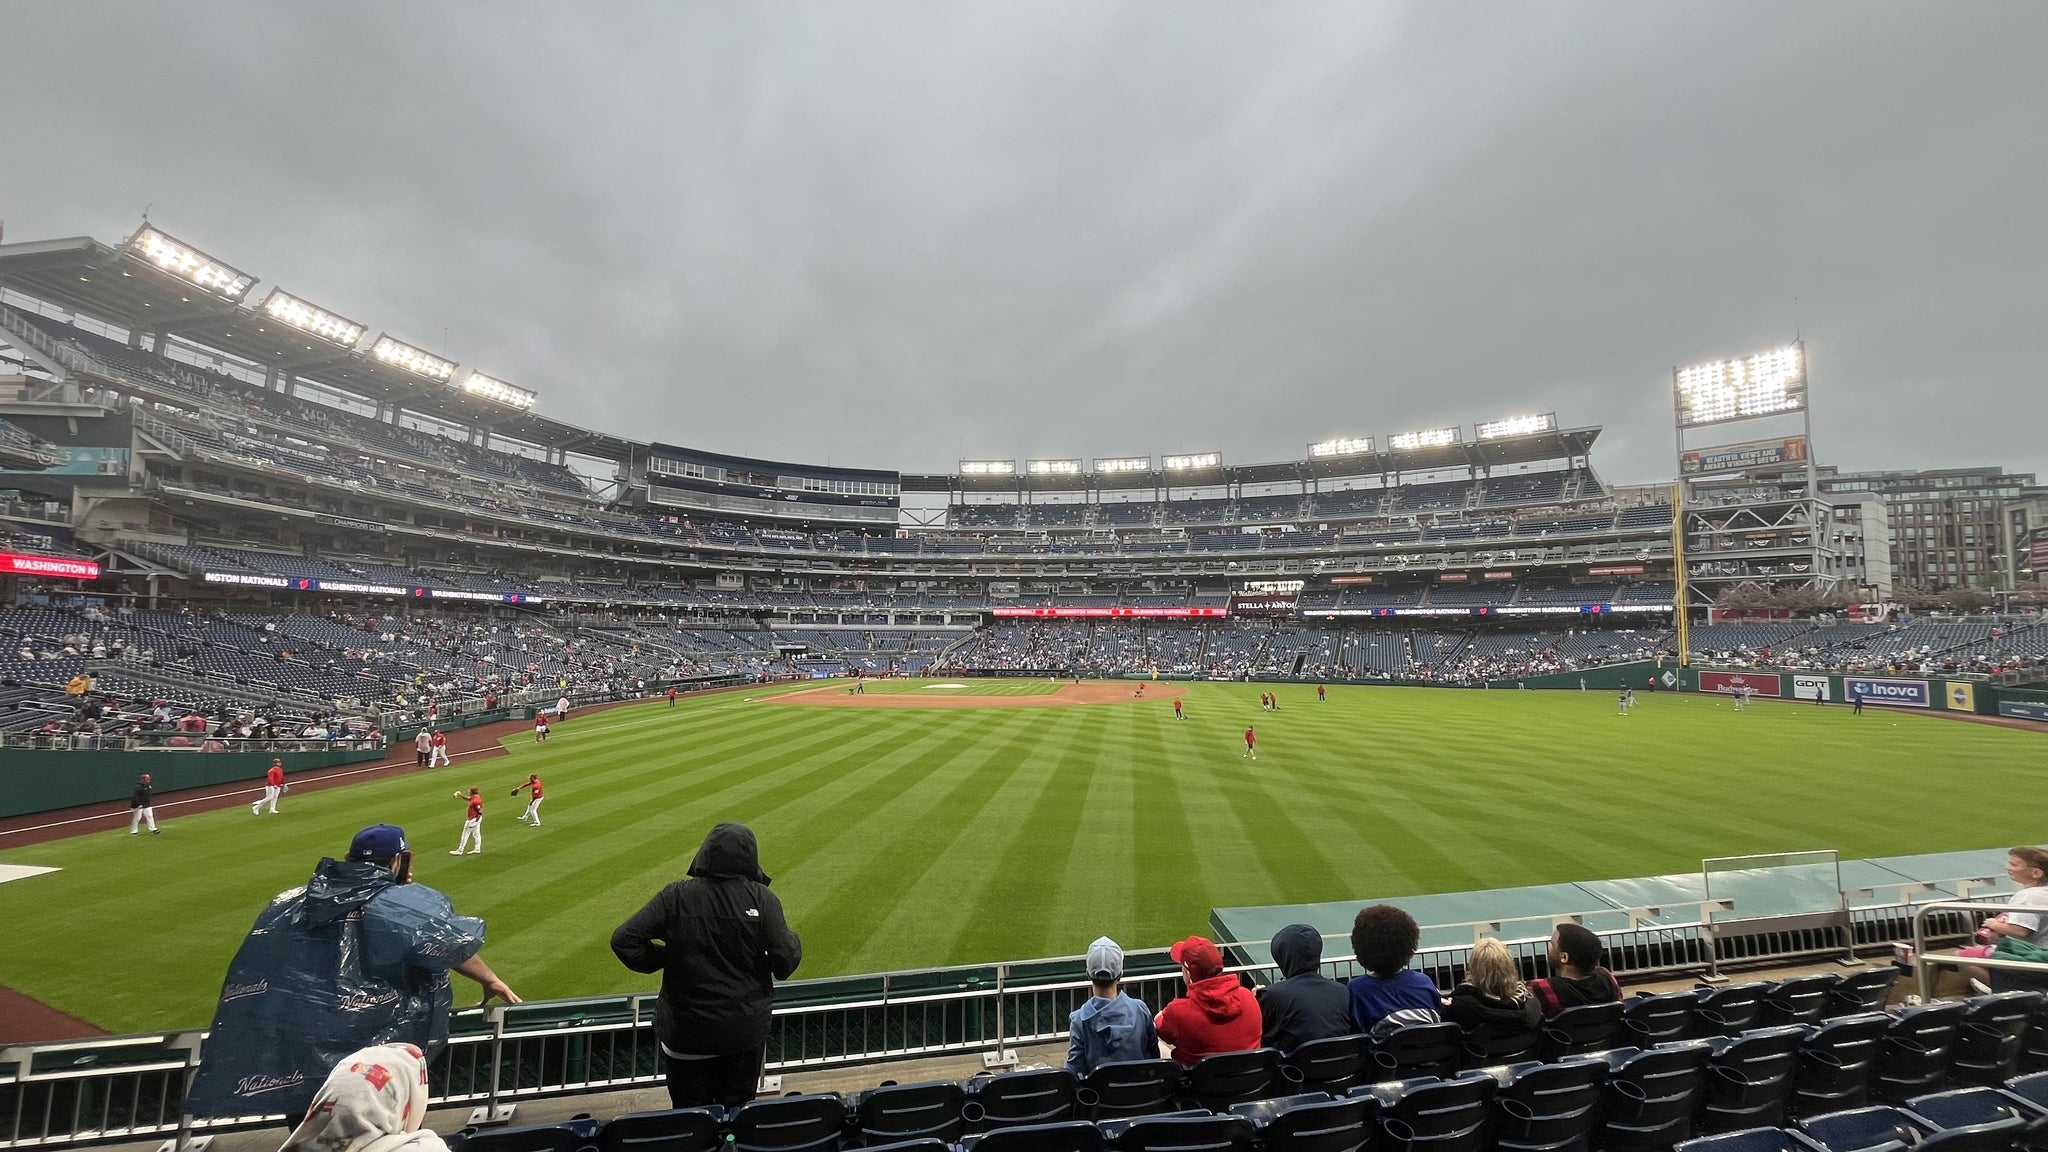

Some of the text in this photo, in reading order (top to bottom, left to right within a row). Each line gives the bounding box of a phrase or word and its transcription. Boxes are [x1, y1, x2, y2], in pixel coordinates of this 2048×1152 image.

[1704, 454, 1781, 471] AWARD WINNING BREWS
[1706, 453, 1738, 464] BEAUTIFUL
[1740, 450, 1761, 460] VIEWS
[1762, 447, 1776, 457] AND
[334, 518, 369, 530] CHAMPIONS
[13, 558, 86, 575] WASHINGTON
[240, 575, 289, 587] NATIONALS
[319, 581, 407, 595] WASHINGTON NATIONALS
[431, 589, 503, 601] WASHINGTON NATIONALS
[1795, 680, 1827, 688] GDIT
[1872, 683, 1918, 697] Inova
[233, 1069, 304, 1097] Nationals
